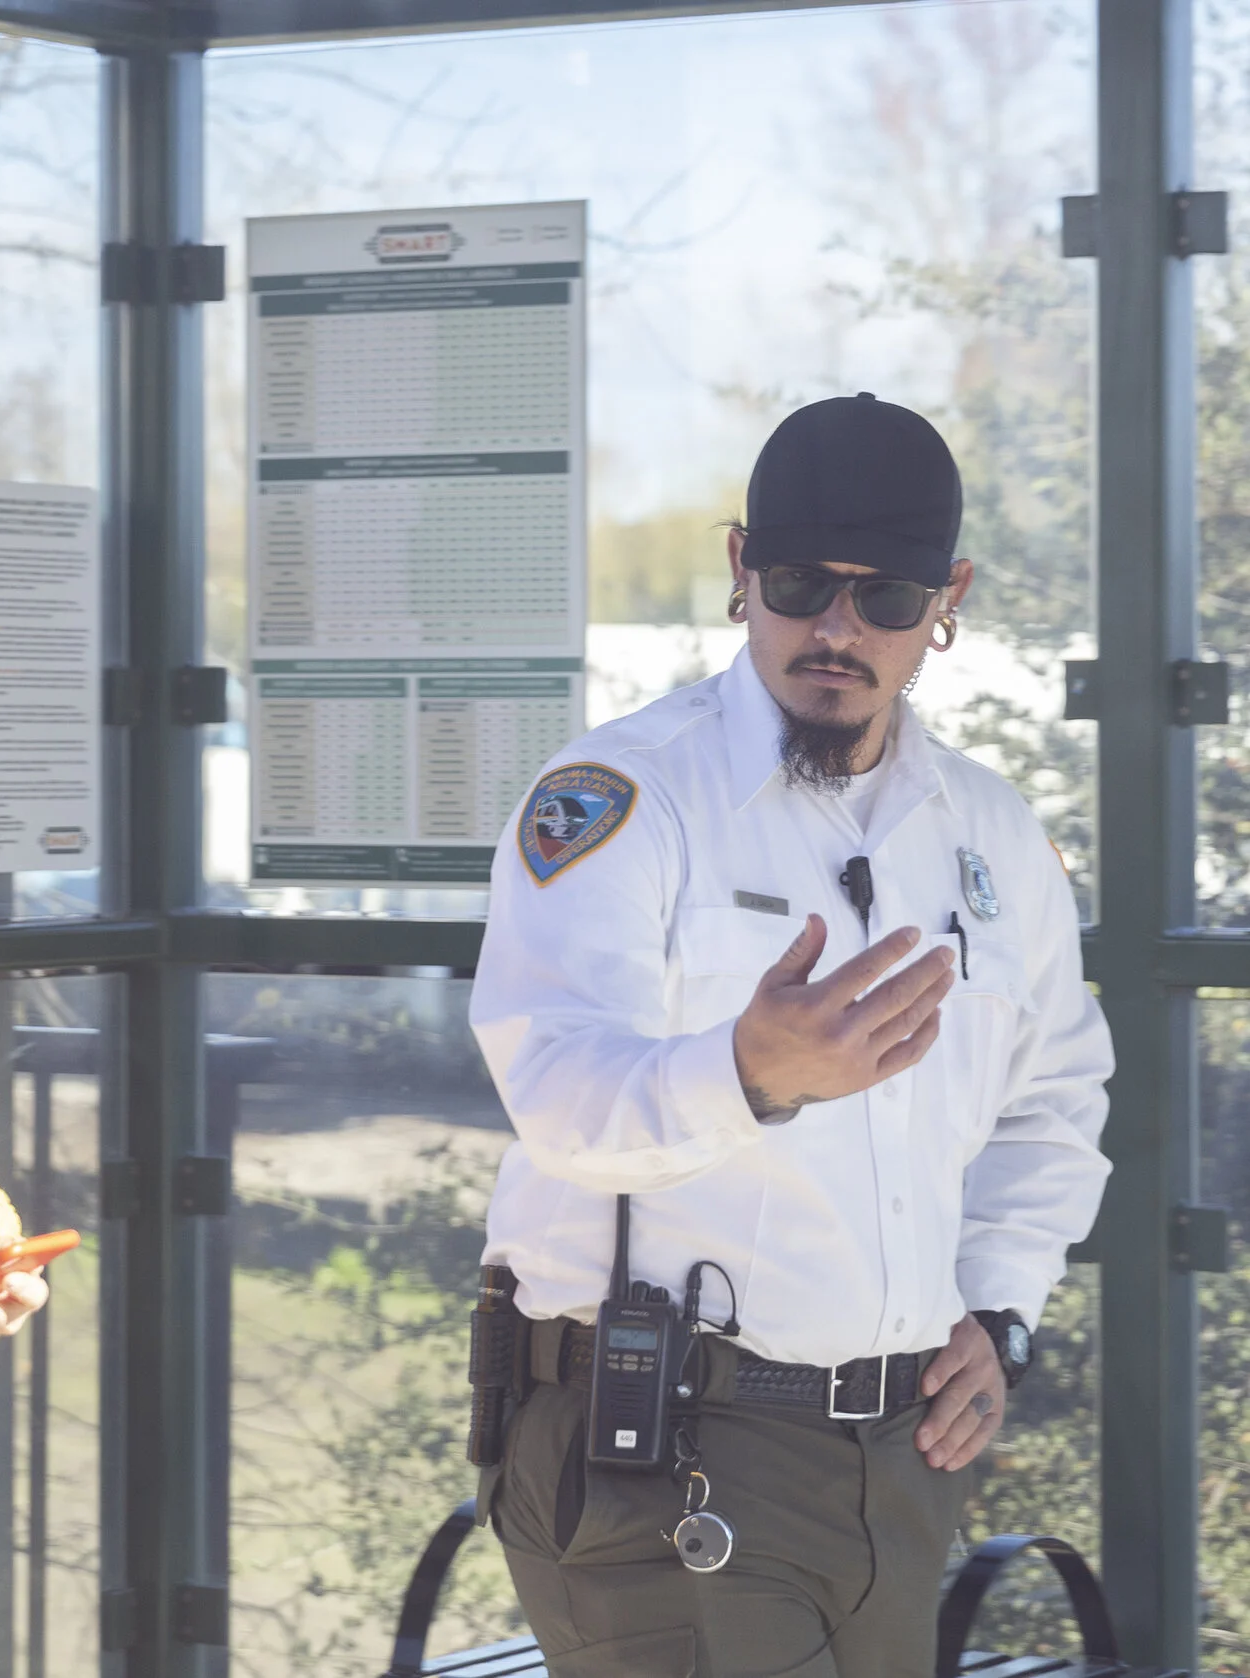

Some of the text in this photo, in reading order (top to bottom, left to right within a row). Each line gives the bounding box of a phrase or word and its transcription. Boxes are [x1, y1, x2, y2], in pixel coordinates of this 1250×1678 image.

[539, 769, 629, 795] SONOMA-MARIN
[547, 778, 610, 794] AREA RAIL
[555, 810, 622, 865] OPERATIONS
